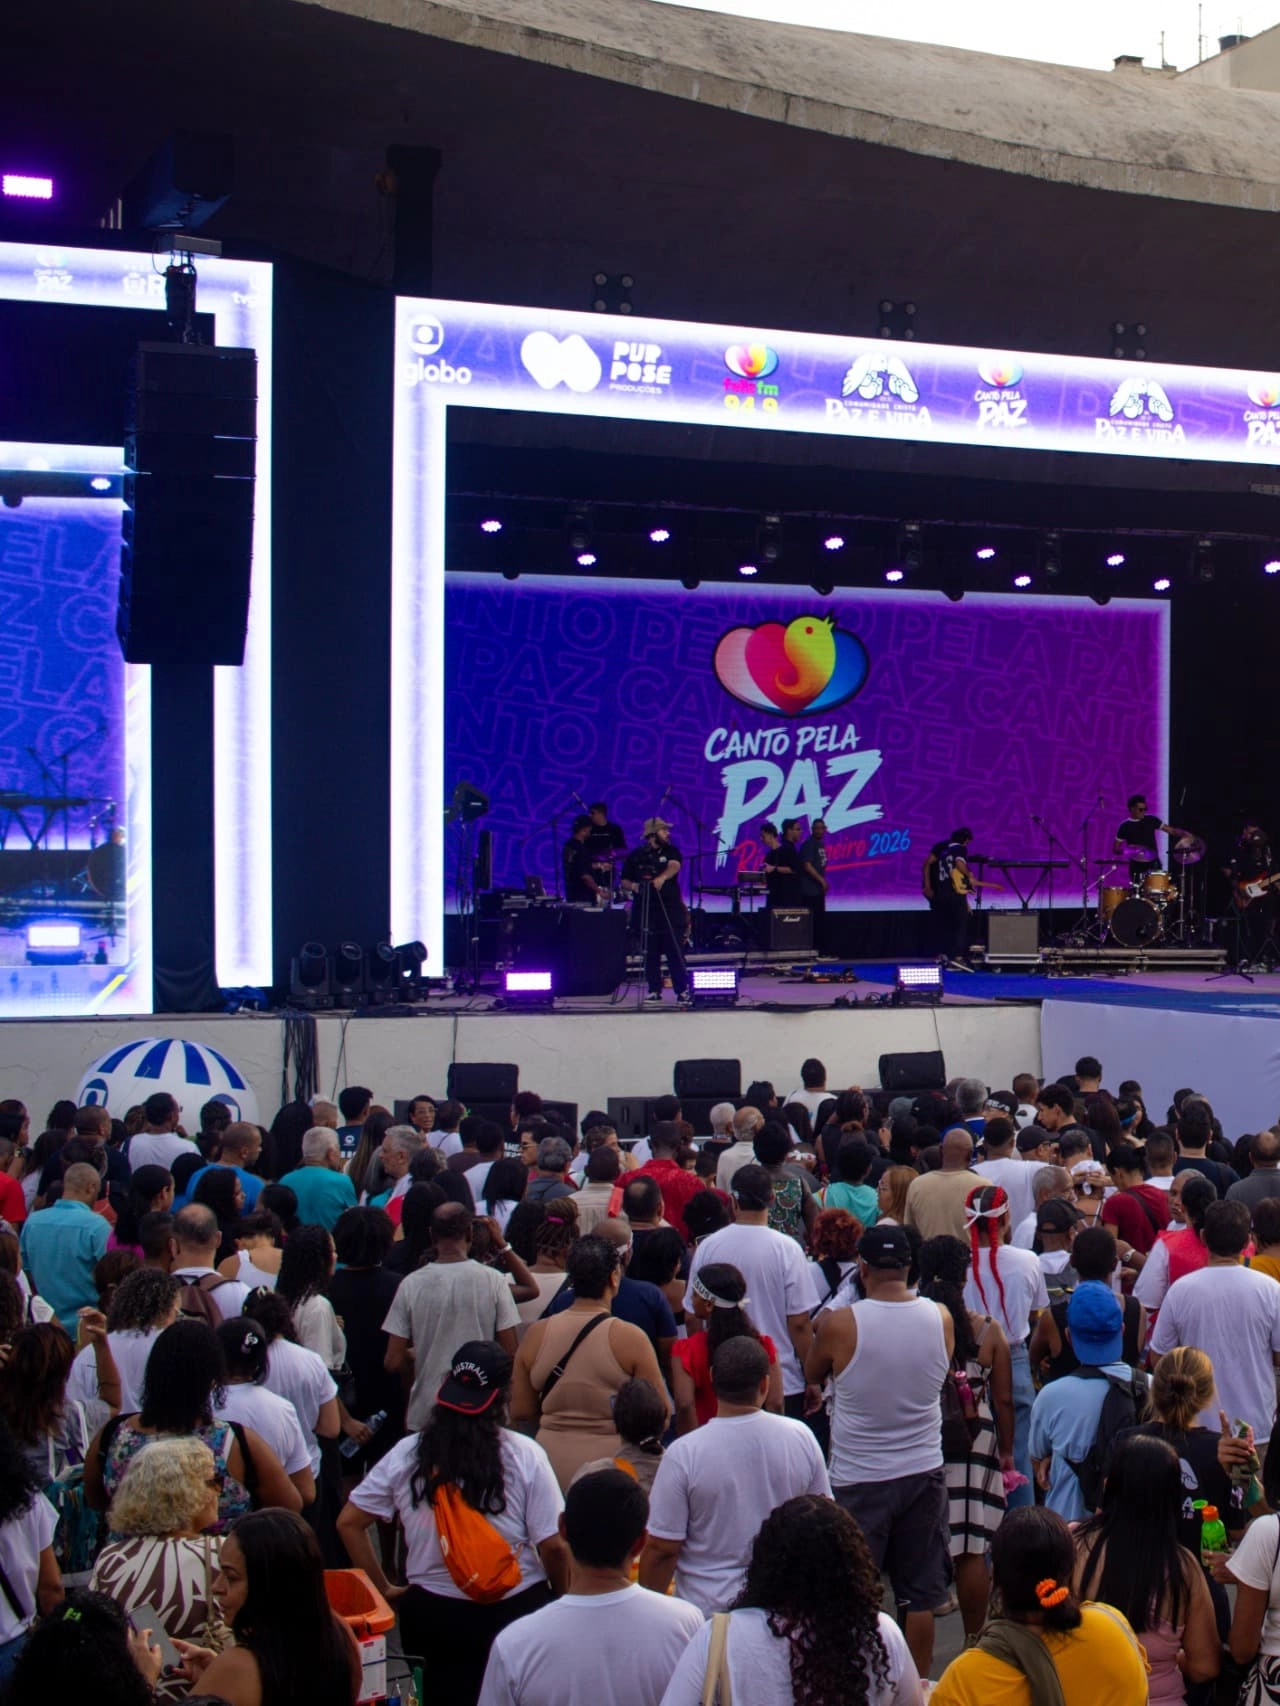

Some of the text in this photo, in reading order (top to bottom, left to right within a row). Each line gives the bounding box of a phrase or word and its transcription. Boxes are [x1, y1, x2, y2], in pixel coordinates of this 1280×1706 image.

[612, 341, 662, 364] PUR
[405, 358, 472, 387] globo
[610, 361, 672, 385] POSE
[975, 390, 999, 402] CANTO
[825, 398, 863, 424] PAZ
[977, 400, 1028, 432] PAZ
[1243, 410, 1267, 422] CANTO
[1095, 418, 1126, 442] PAZ
[704, 723, 861, 762] CANTO PELA
[712, 749, 885, 872] PAZ
[867, 829, 912, 857] 2026
[453, 1361, 489, 1387] AUSTRALIA
